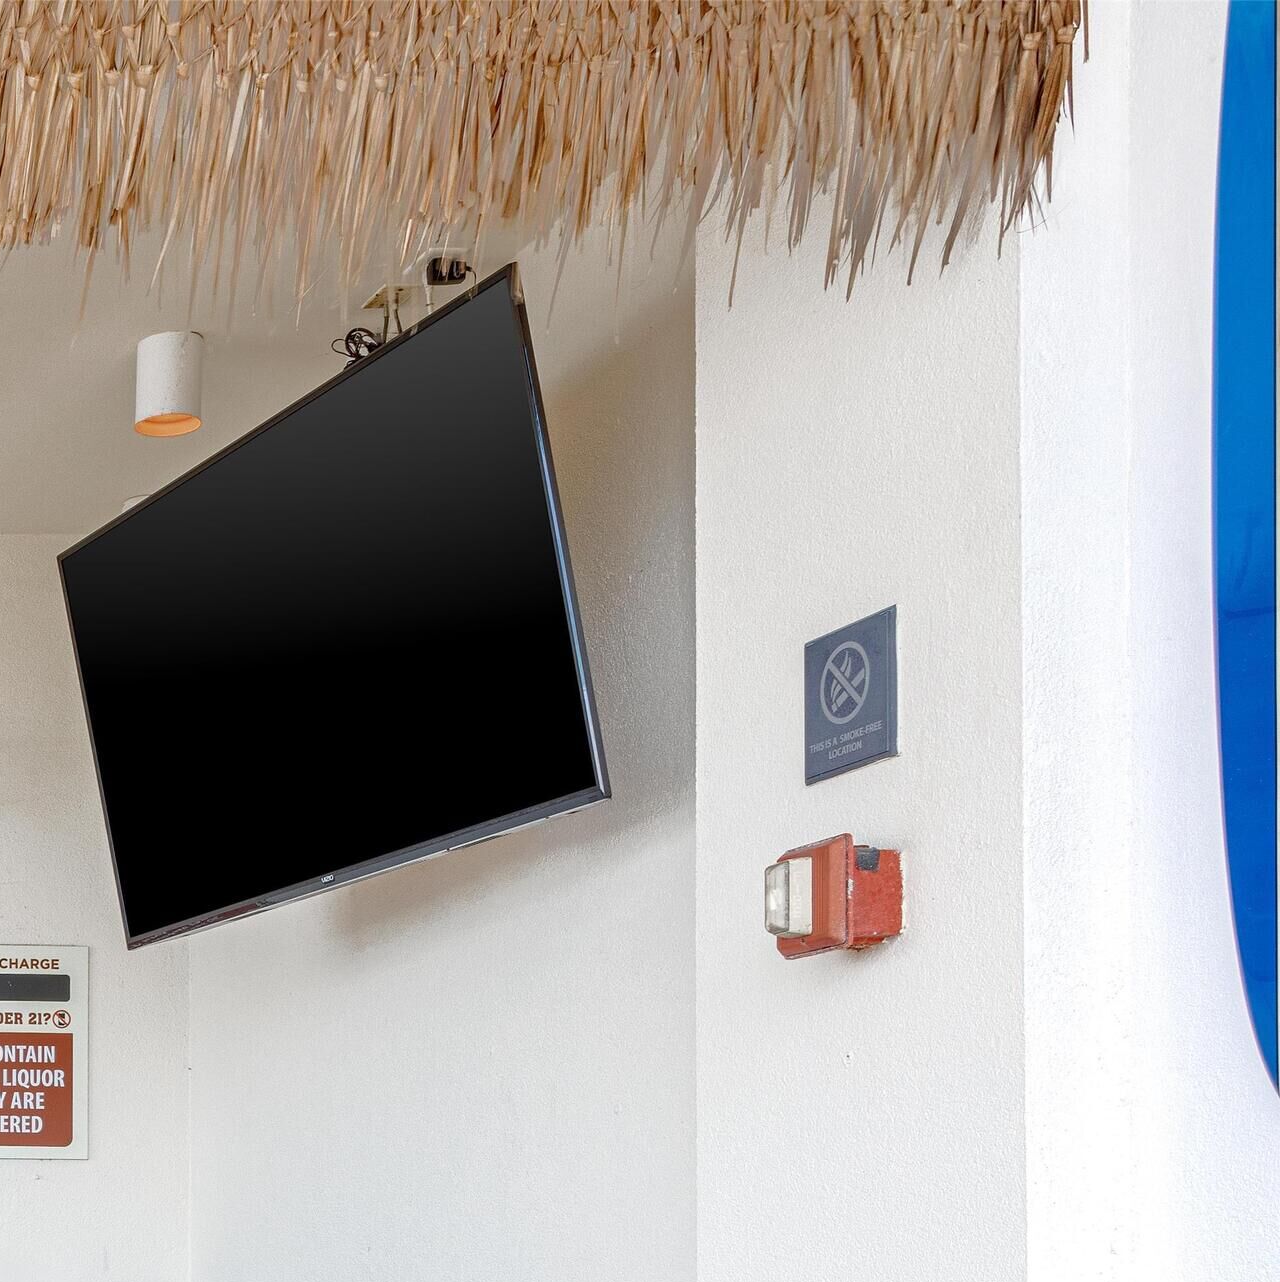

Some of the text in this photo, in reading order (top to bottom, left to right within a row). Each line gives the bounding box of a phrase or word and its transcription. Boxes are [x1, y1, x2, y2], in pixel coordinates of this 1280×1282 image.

[809, 720, 882, 753] THIS IS A SMOKE-FREE
[828, 740, 862, 760] LOCATION
[28, 1012, 52, 1025] 21?
[2, 1068, 65, 1089] LIQUOR
[10, 1091, 45, 1110] ARE
